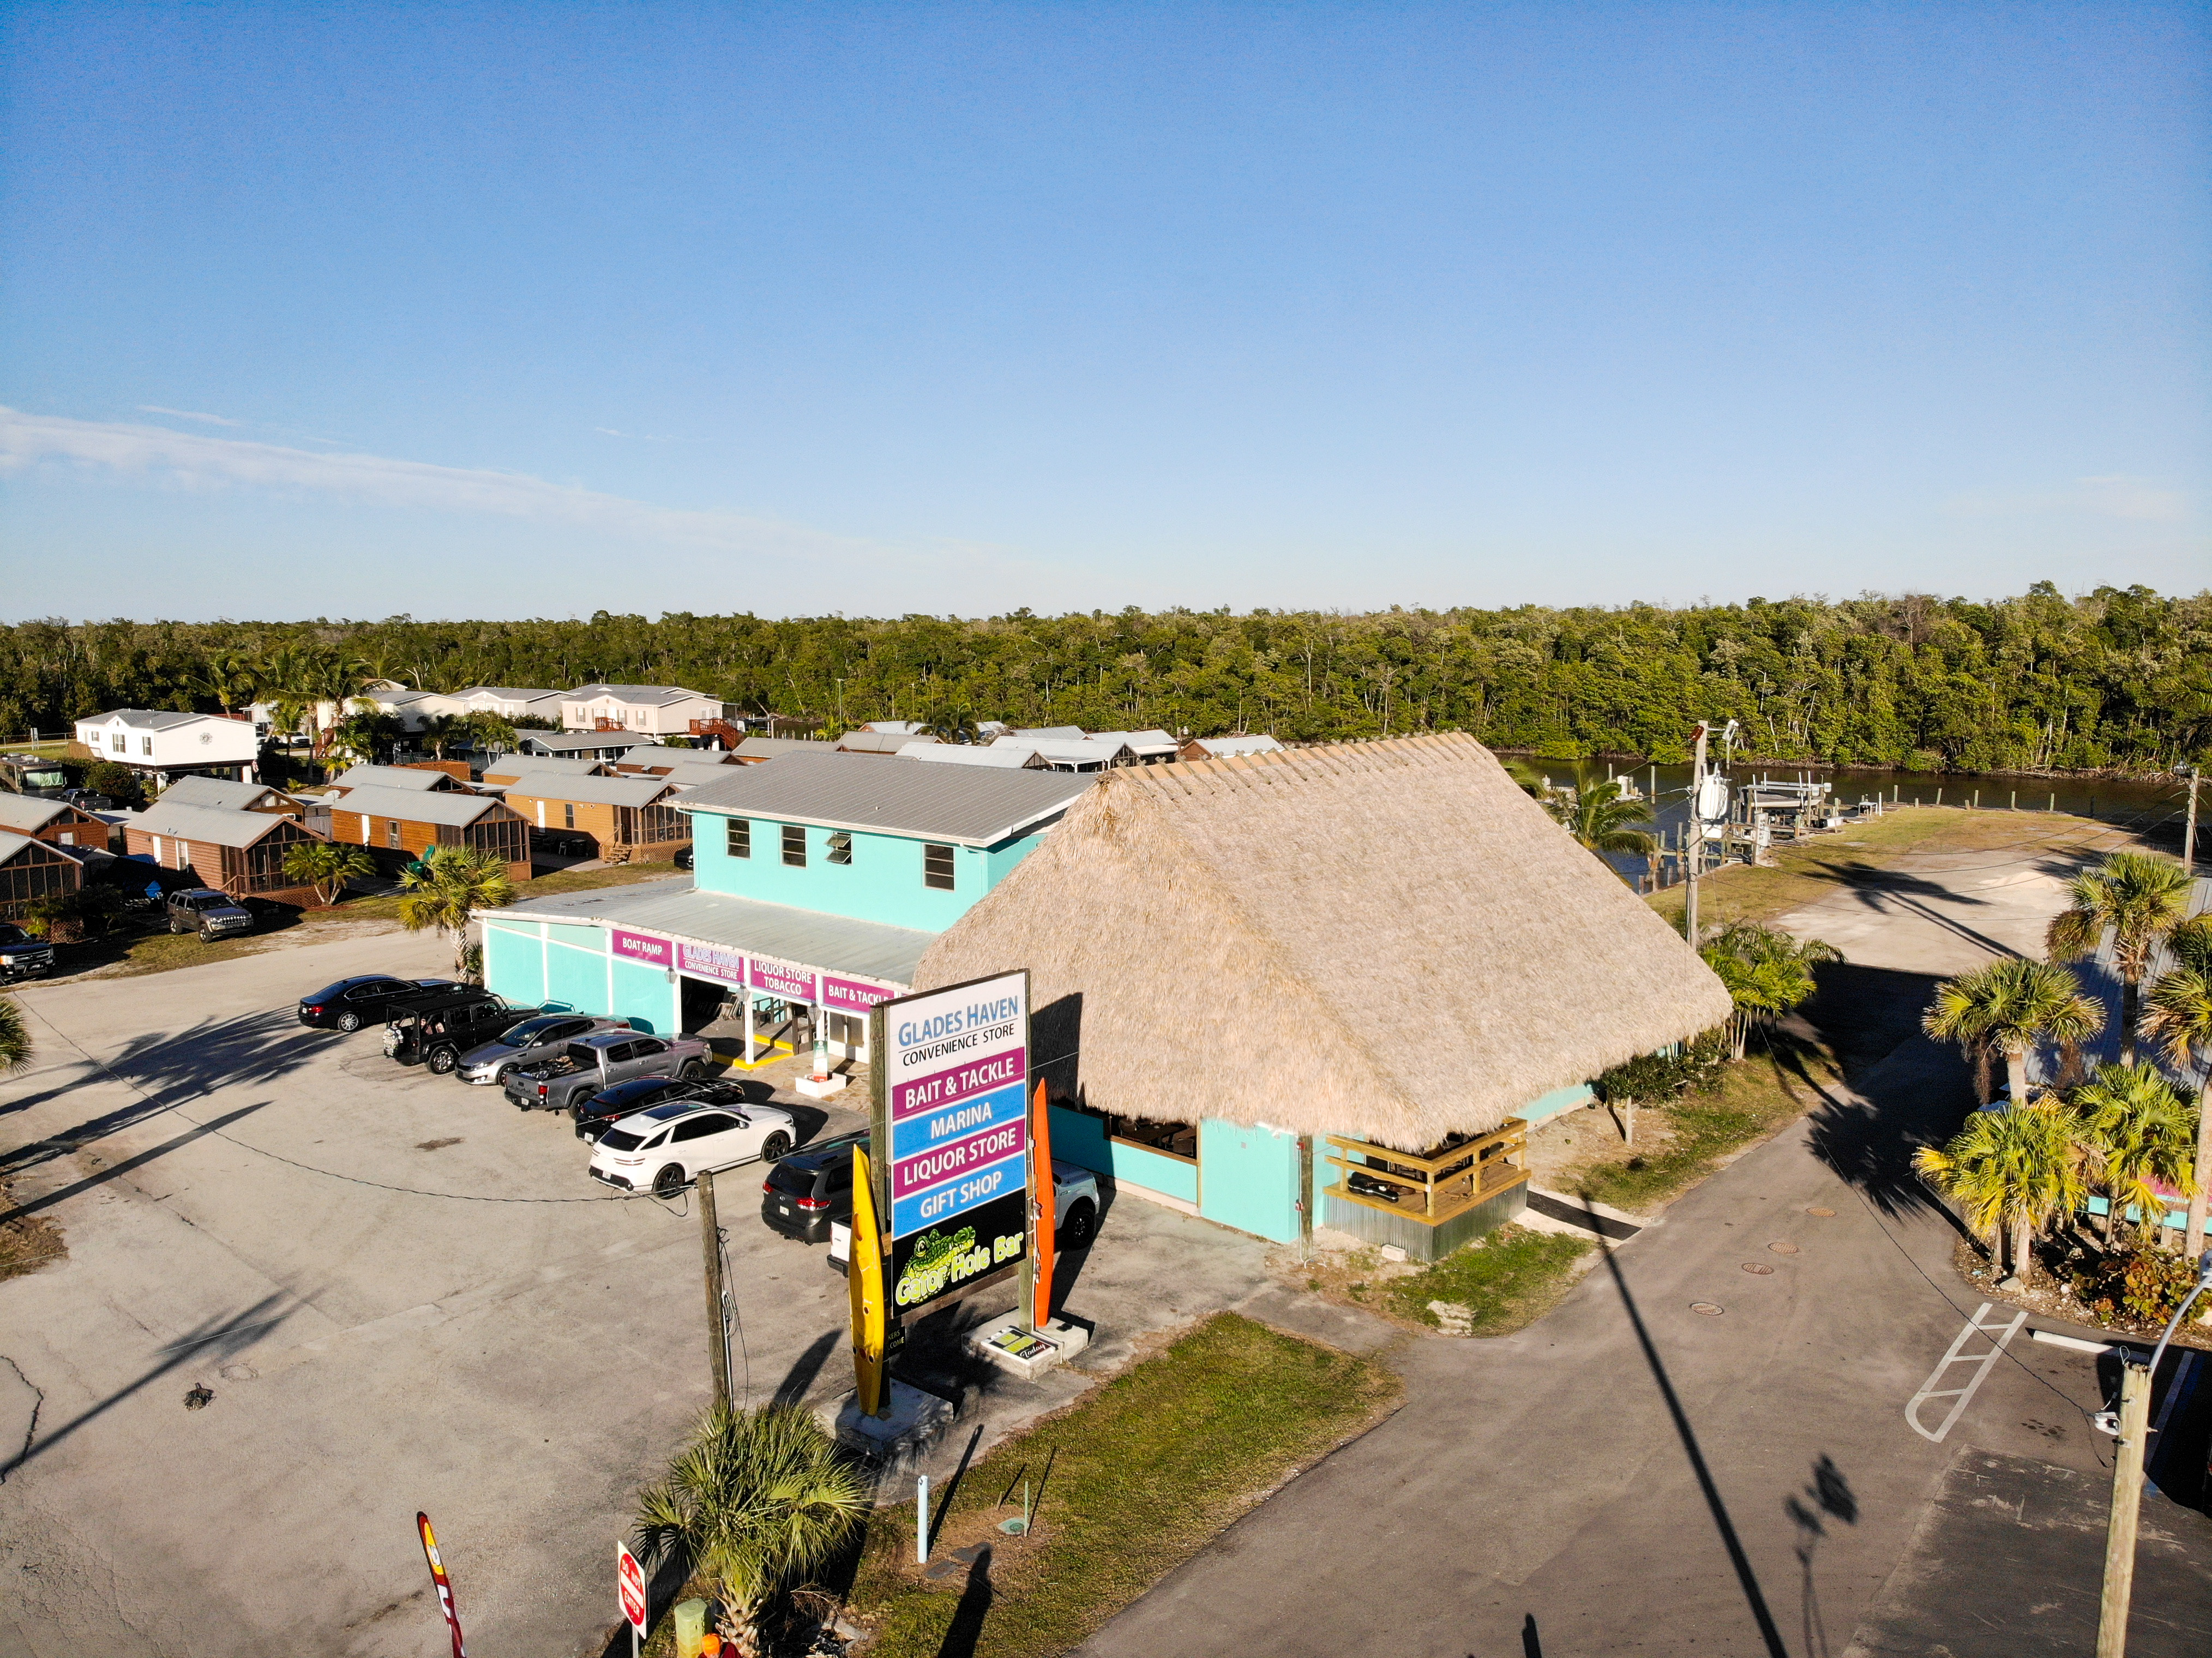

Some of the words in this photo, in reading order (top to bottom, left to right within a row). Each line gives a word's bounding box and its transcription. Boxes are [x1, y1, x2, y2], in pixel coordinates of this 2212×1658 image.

[622, 938, 641, 951] BOAT
[642, 942, 662, 955] RAMP
[683, 944, 711, 962] GLADES
[713, 950, 739, 969] HAVEN
[685, 960, 719, 976] CONVENIENCE
[721, 969, 737, 980] STORE
[754, 960, 784, 978] LIQUOR
[786, 969, 812, 984] STORE
[764, 976, 802, 995] TOBACCO
[828, 985, 847, 999] BAIT
[849, 990, 856, 1001] &
[898, 1010, 963, 1047] GLADES
[967, 995, 1018, 1028] HAVEN
[903, 1034, 978, 1066] CONVENIENCE
[983, 1023, 1014, 1043] STORE
[905, 1080, 941, 1109] BAIT
[945, 1076, 957, 1096] &
[960, 1057, 1014, 1090] TACKLE
[931, 1102, 992, 1139] MARINA
[904, 1146, 965, 1186] LIQUOR
[969, 1127, 1016, 1161] STORE
[921, 1188, 957, 1218] GIFT
[960, 1171, 1002, 1203] SHOP
[895, 1265, 947, 1306] Gator
[951, 1245, 990, 1282] Hole
[994, 1232, 1024, 1264] Bar
[1020, 1343, 1046, 1357] Today
[622, 1559, 629, 1575] DO
[631, 1570, 640, 1589] NOT
[624, 1590, 640, 1618] ENTER
